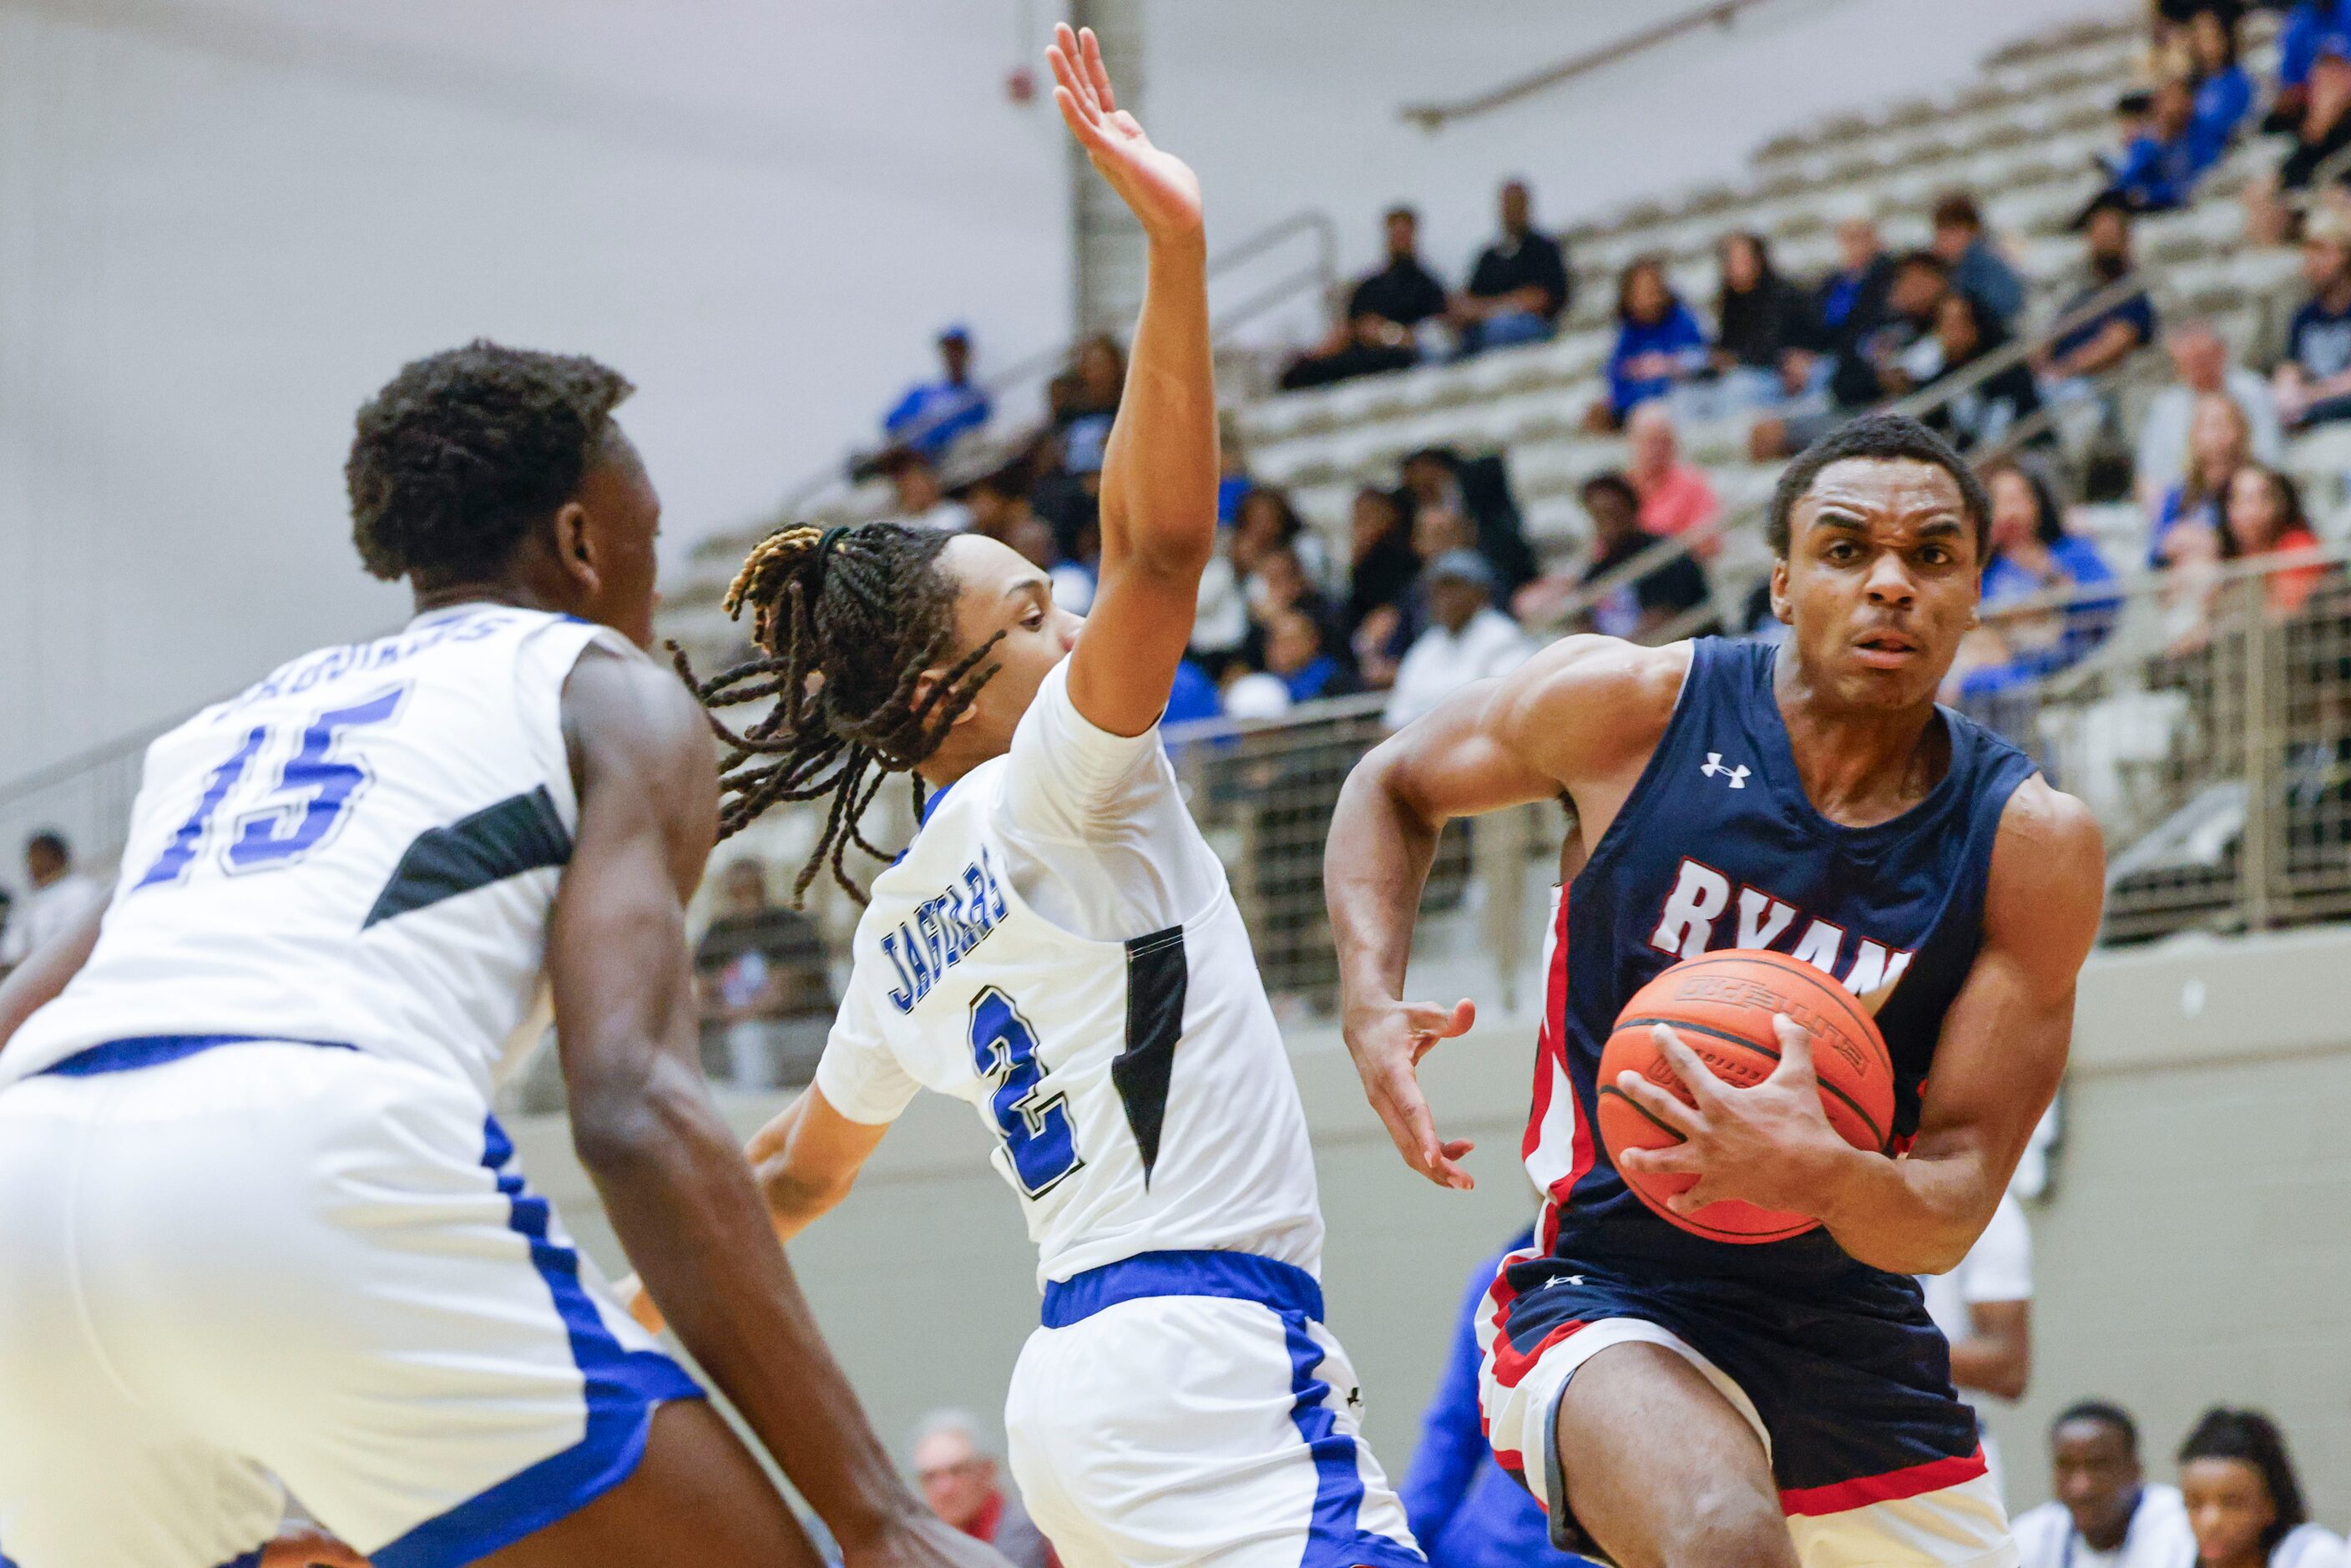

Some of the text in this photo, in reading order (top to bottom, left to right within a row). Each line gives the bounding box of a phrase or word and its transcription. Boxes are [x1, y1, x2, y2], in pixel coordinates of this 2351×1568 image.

[129, 676, 417, 893] 15
[1647, 854, 1918, 1019] RYAN
[967, 984, 1086, 1201] 2
